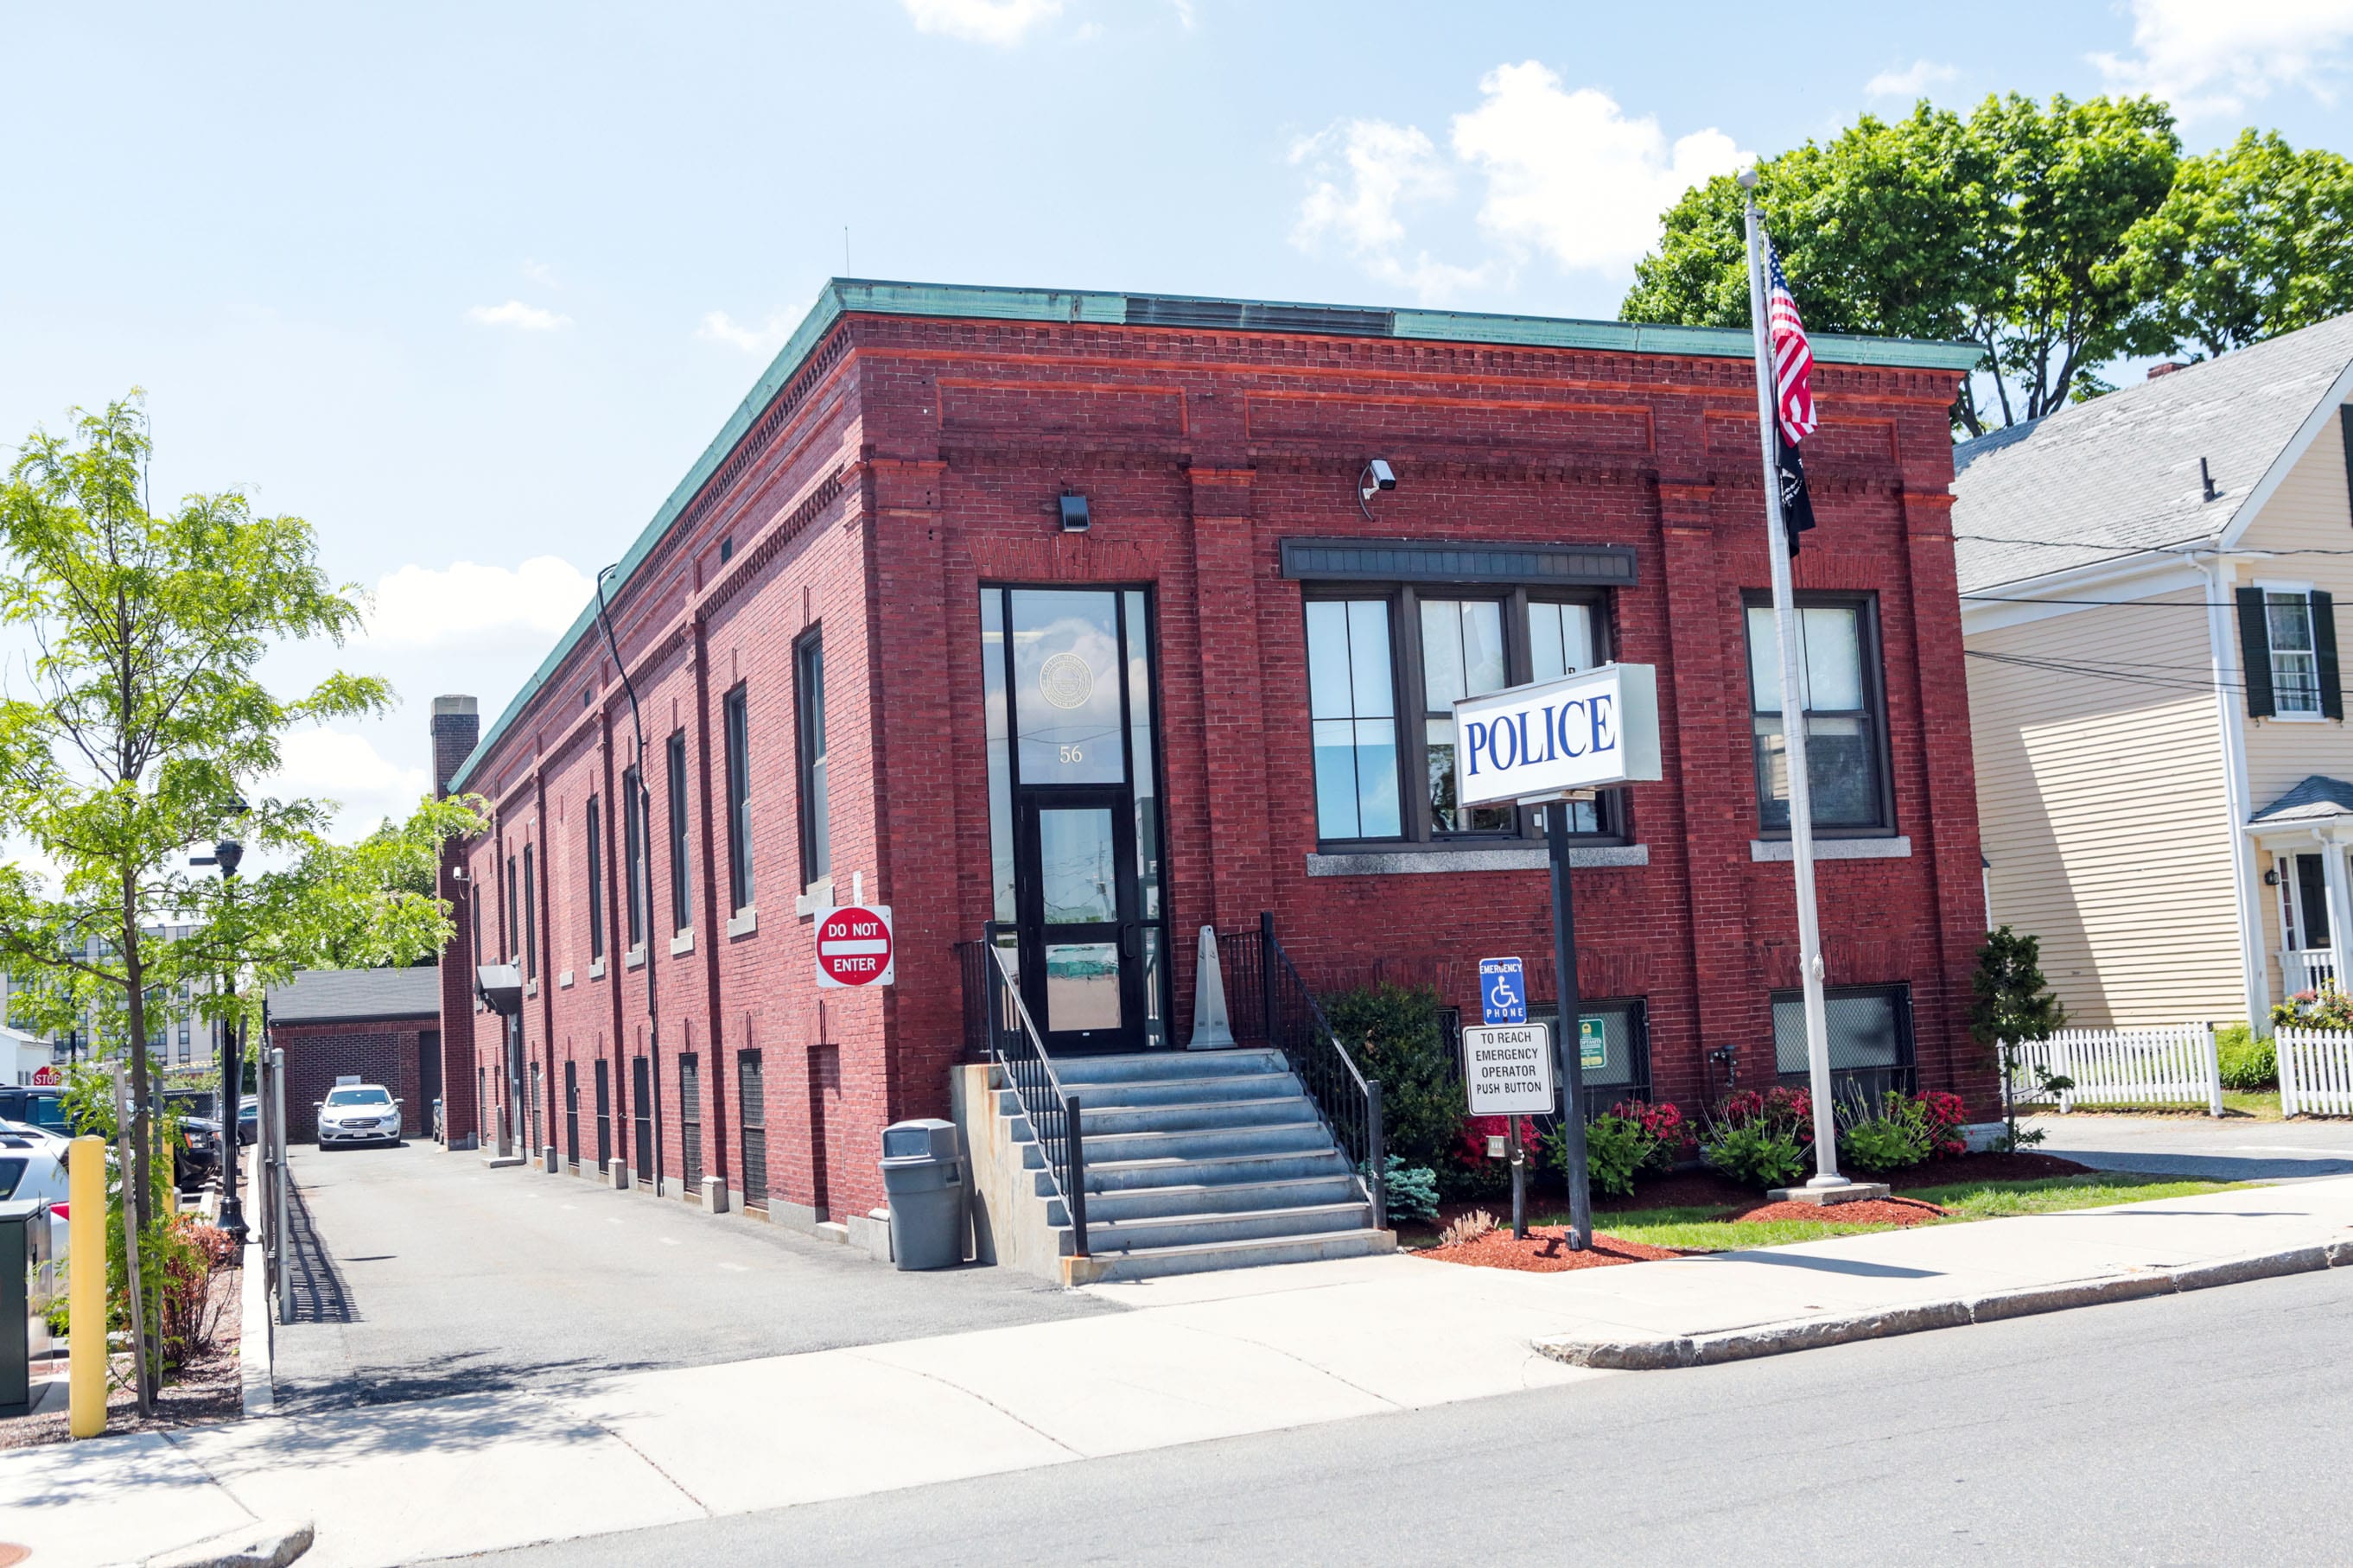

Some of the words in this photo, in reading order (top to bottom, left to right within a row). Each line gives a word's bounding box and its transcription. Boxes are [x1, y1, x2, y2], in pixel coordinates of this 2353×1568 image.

[1465, 695, 1615, 776] POLICE
[1059, 746, 1083, 764] 56
[829, 924, 847, 937] DO
[853, 923, 878, 936] NOT
[834, 957, 876, 972] ENTER
[1479, 963, 1522, 974] EMERGENCY
[1486, 1007, 1523, 1018] PHONE
[1480, 1032, 1494, 1044] TO
[1498, 1031, 1531, 1044] REACH
[1475, 1048, 1538, 1061] EMERGENCY
[1481, 1065, 1536, 1078] OPERATOR
[35, 1074, 60, 1085] STOP
[1476, 1082, 1500, 1095] PUSH
[1504, 1082, 1542, 1094] BUTTON
